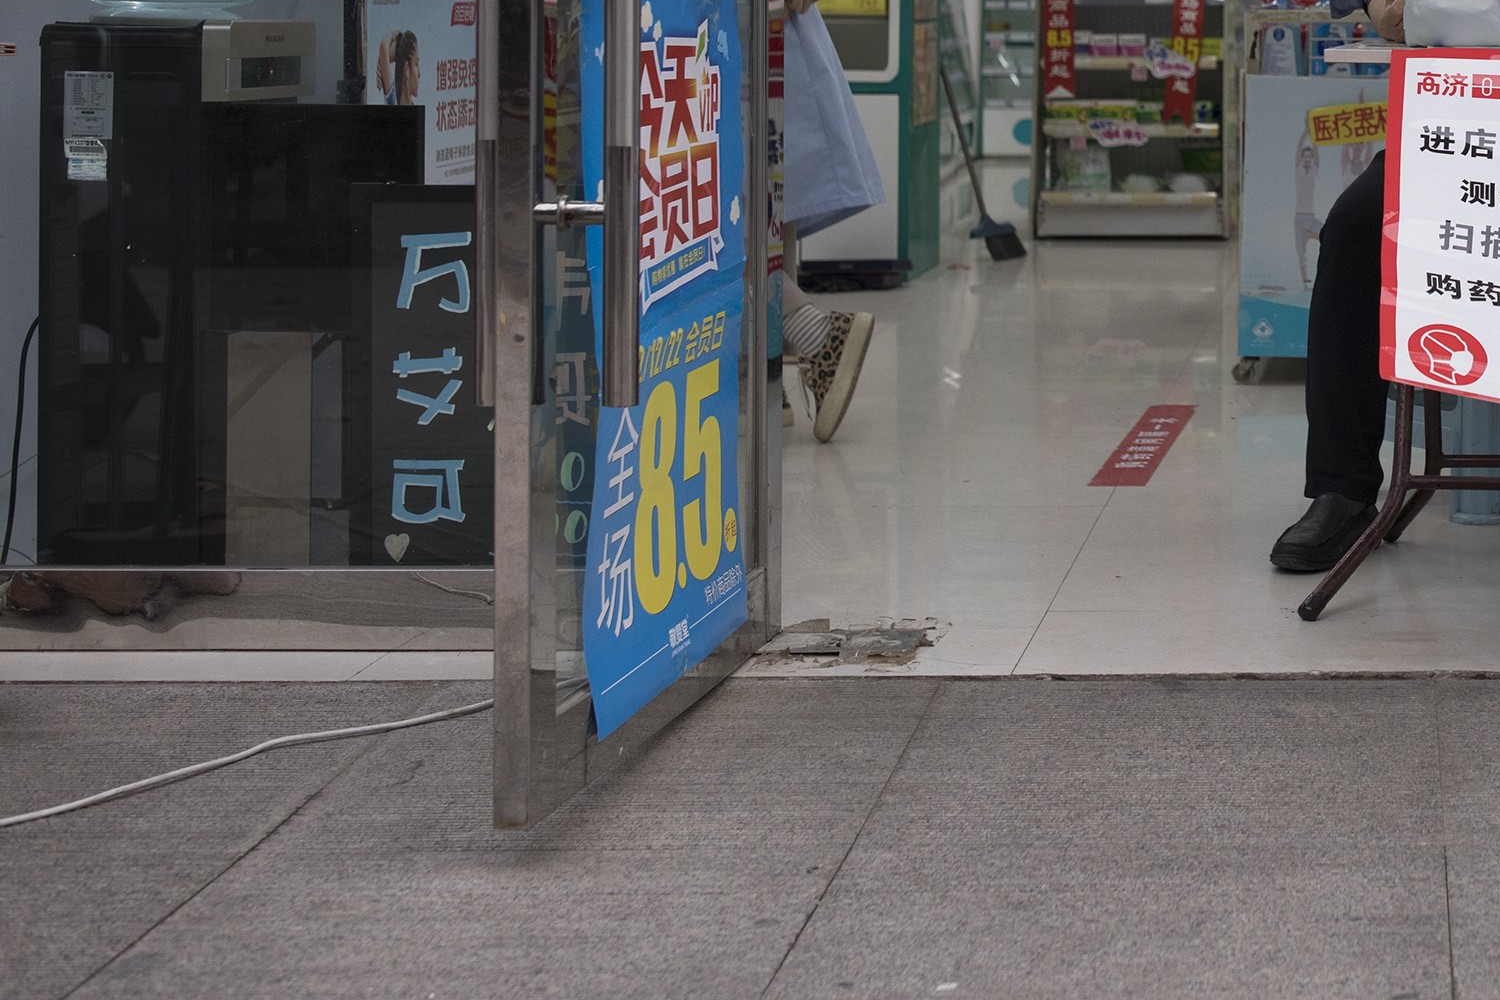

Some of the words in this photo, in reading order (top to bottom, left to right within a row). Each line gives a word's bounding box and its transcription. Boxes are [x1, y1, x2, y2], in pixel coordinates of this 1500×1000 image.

[1416, 71, 1469, 99] 高济
[685, 310, 726, 364] 会员日
[634, 359, 722, 615] 8.5
[596, 406, 640, 638] 全场
[704, 562, 743, 607] 特价商品除外
